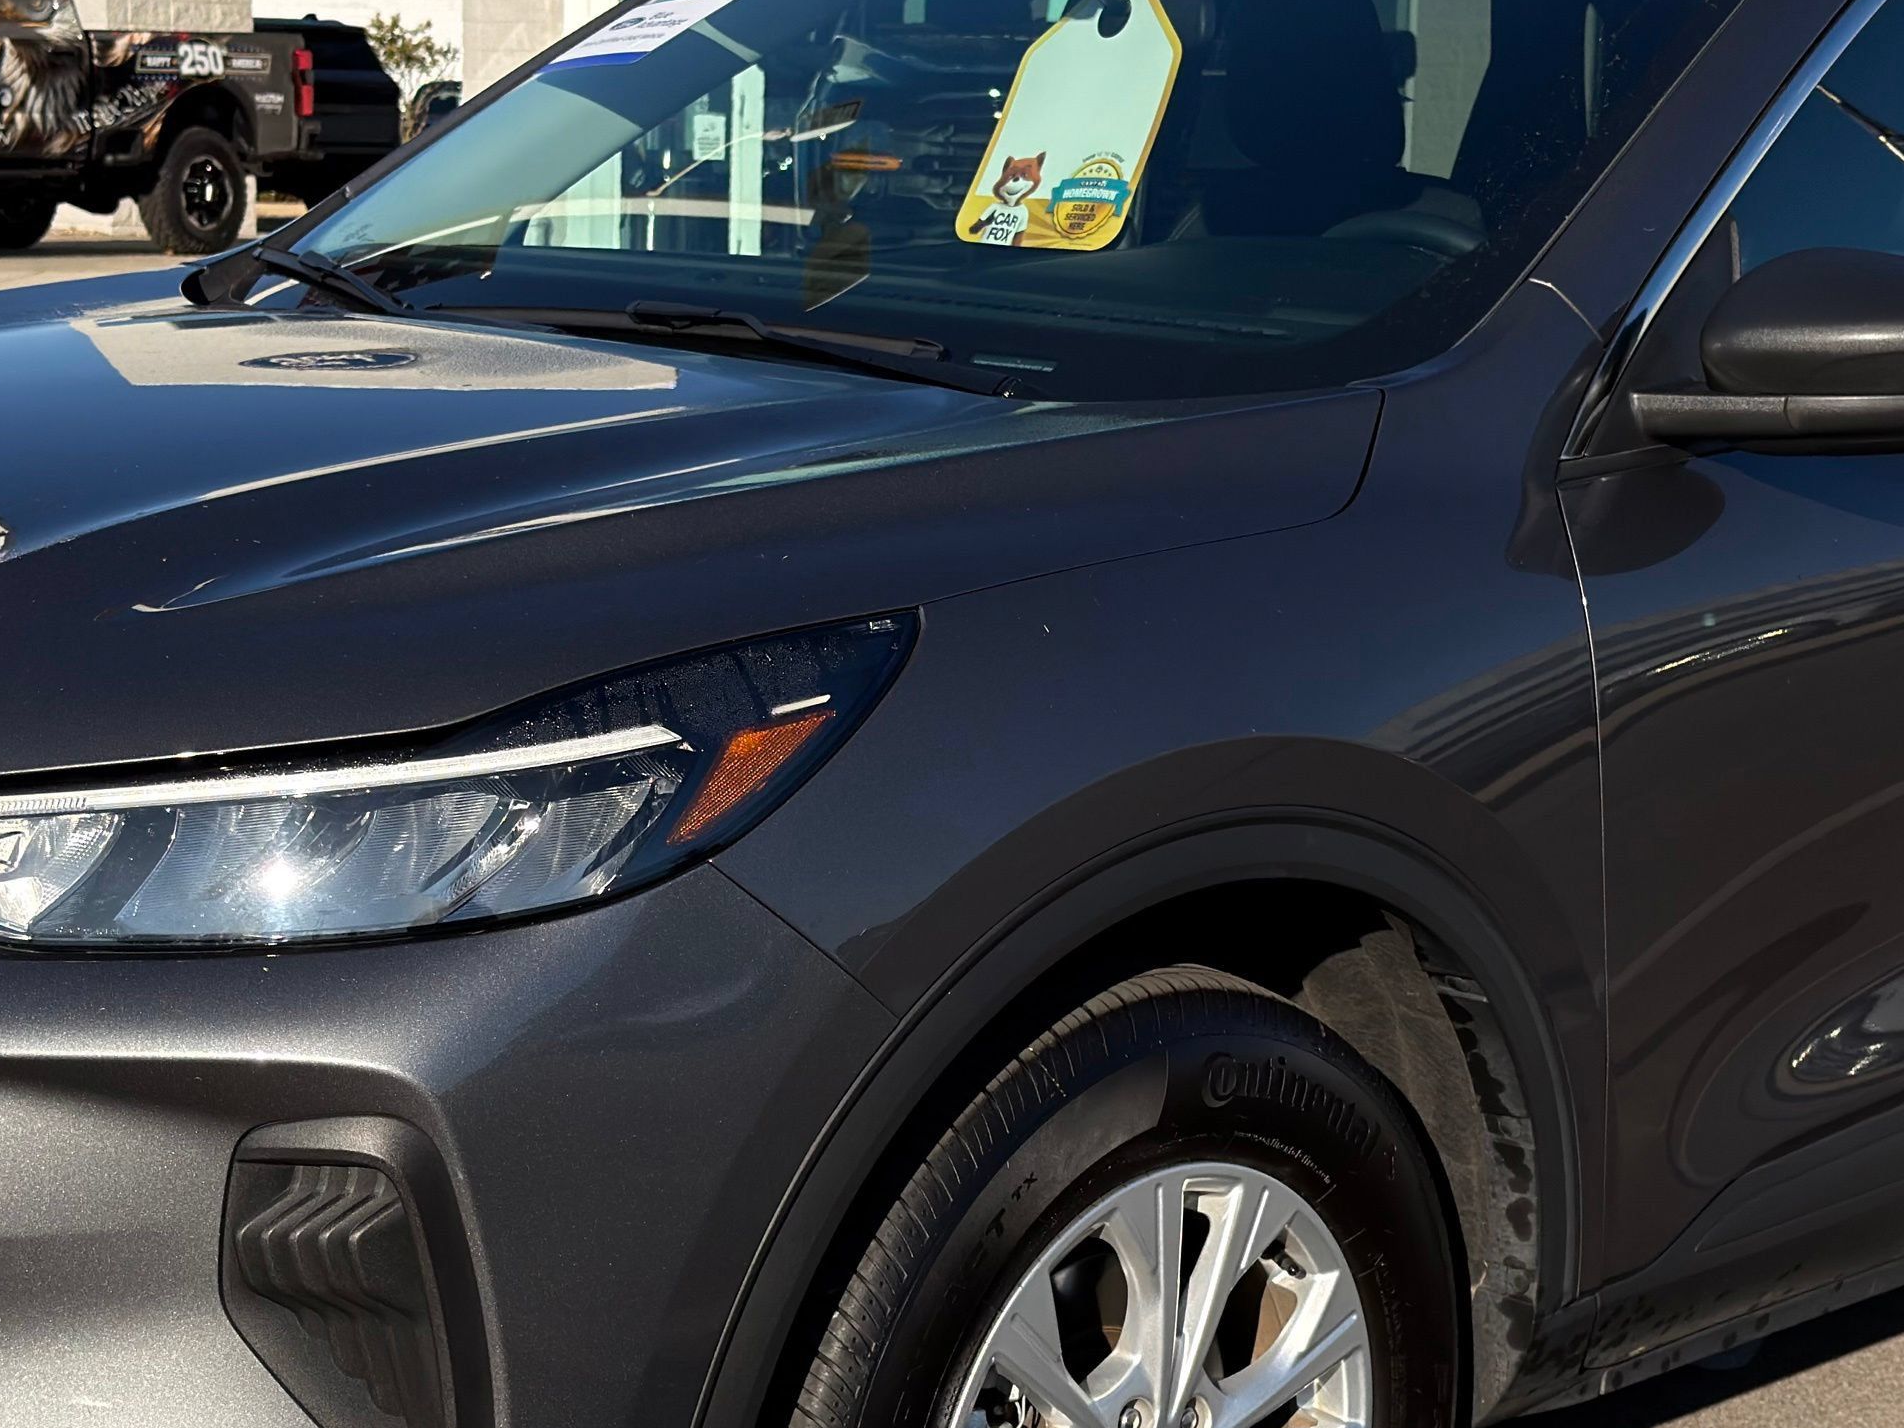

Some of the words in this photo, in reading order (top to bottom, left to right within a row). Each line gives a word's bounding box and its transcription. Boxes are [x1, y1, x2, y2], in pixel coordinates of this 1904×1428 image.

[1062, 187, 1120, 201] HOMEGROWN
[1071, 204, 1088, 212] SOLD
[995, 212, 1019, 228] CAR
[987, 227, 1013, 242] FOX
